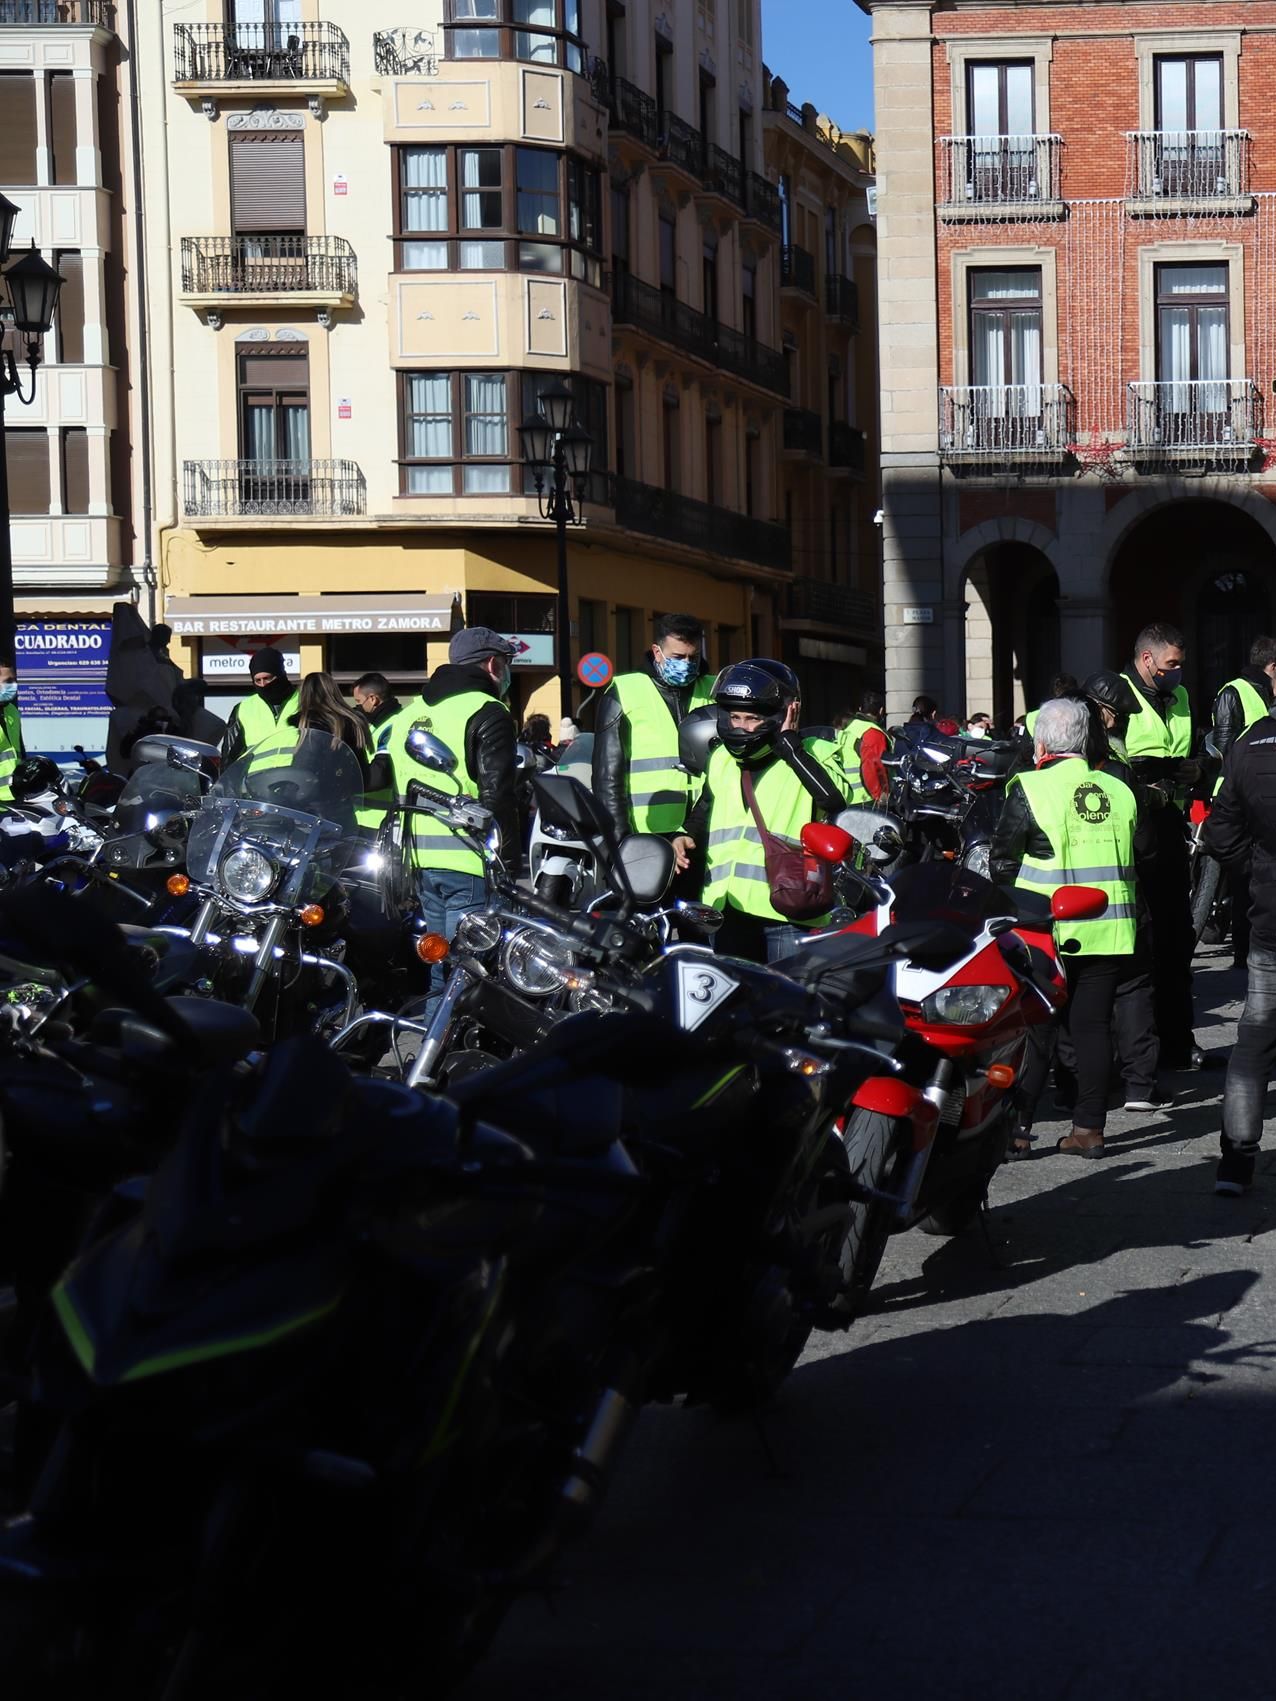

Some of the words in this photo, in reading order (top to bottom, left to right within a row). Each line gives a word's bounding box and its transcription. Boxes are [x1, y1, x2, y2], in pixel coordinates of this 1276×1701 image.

[43, 623, 112, 631] DENTAL
[173, 621, 205, 632] BAR
[209, 619, 317, 632] RESTAURANTE
[321, 618, 373, 630] METRO
[377, 617, 442, 629] ZAMORA
[14, 634, 103, 650] CUADRADO
[209, 658, 245, 668] metro
[688, 973, 717, 1003] 3
